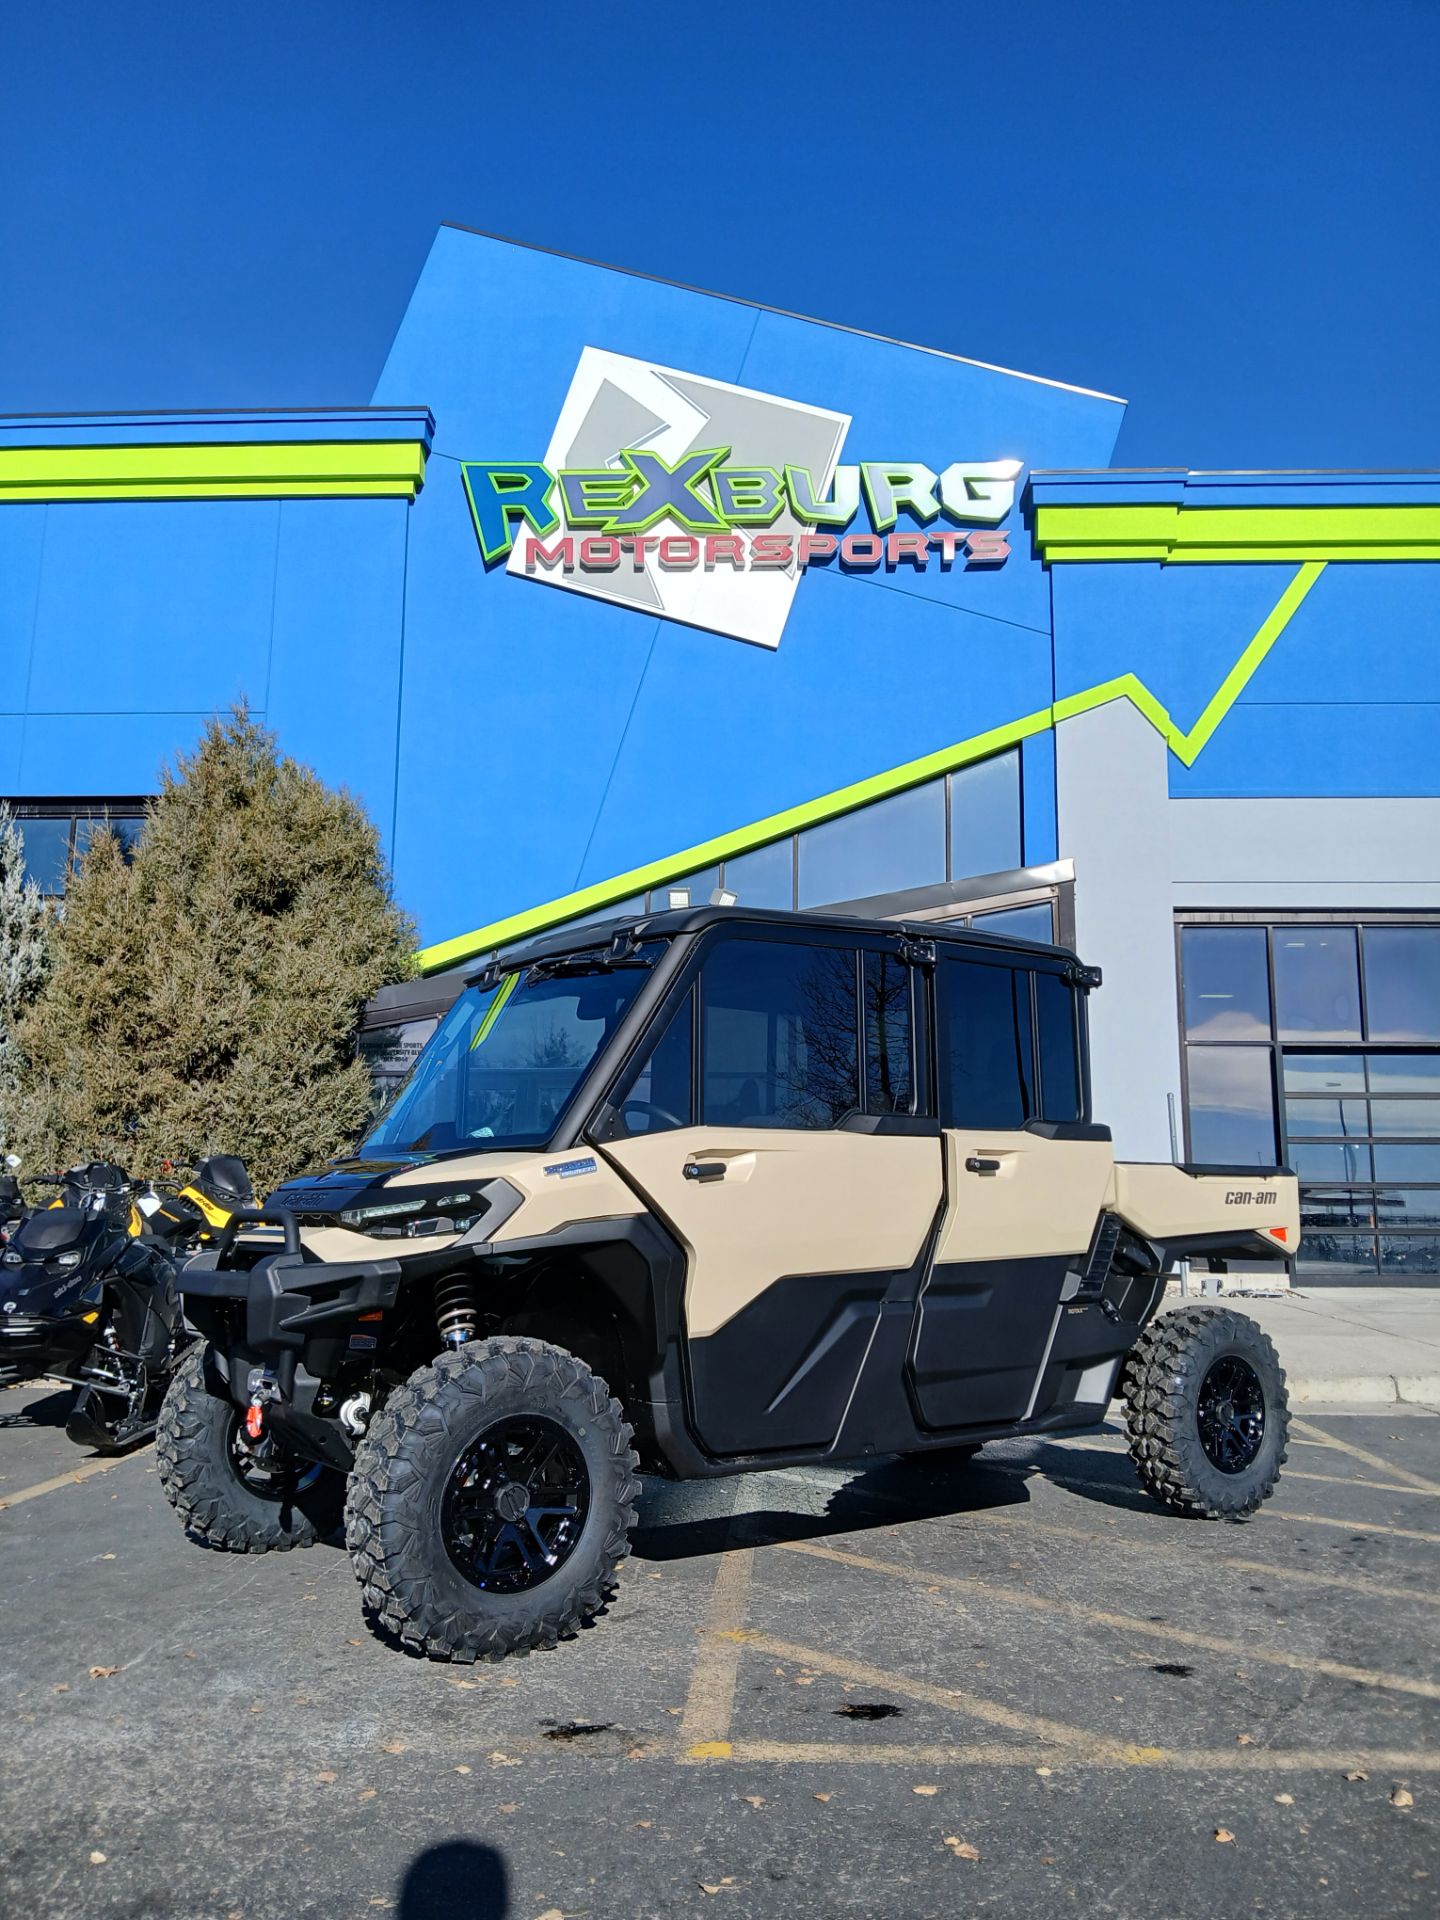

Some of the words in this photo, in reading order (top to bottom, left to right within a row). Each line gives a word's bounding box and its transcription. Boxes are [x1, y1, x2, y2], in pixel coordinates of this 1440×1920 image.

[461, 446, 1024, 565] REXBURG
[526, 530, 1012, 568] MOTORSPORTS
[1225, 1191, 1277, 1205] can-am
